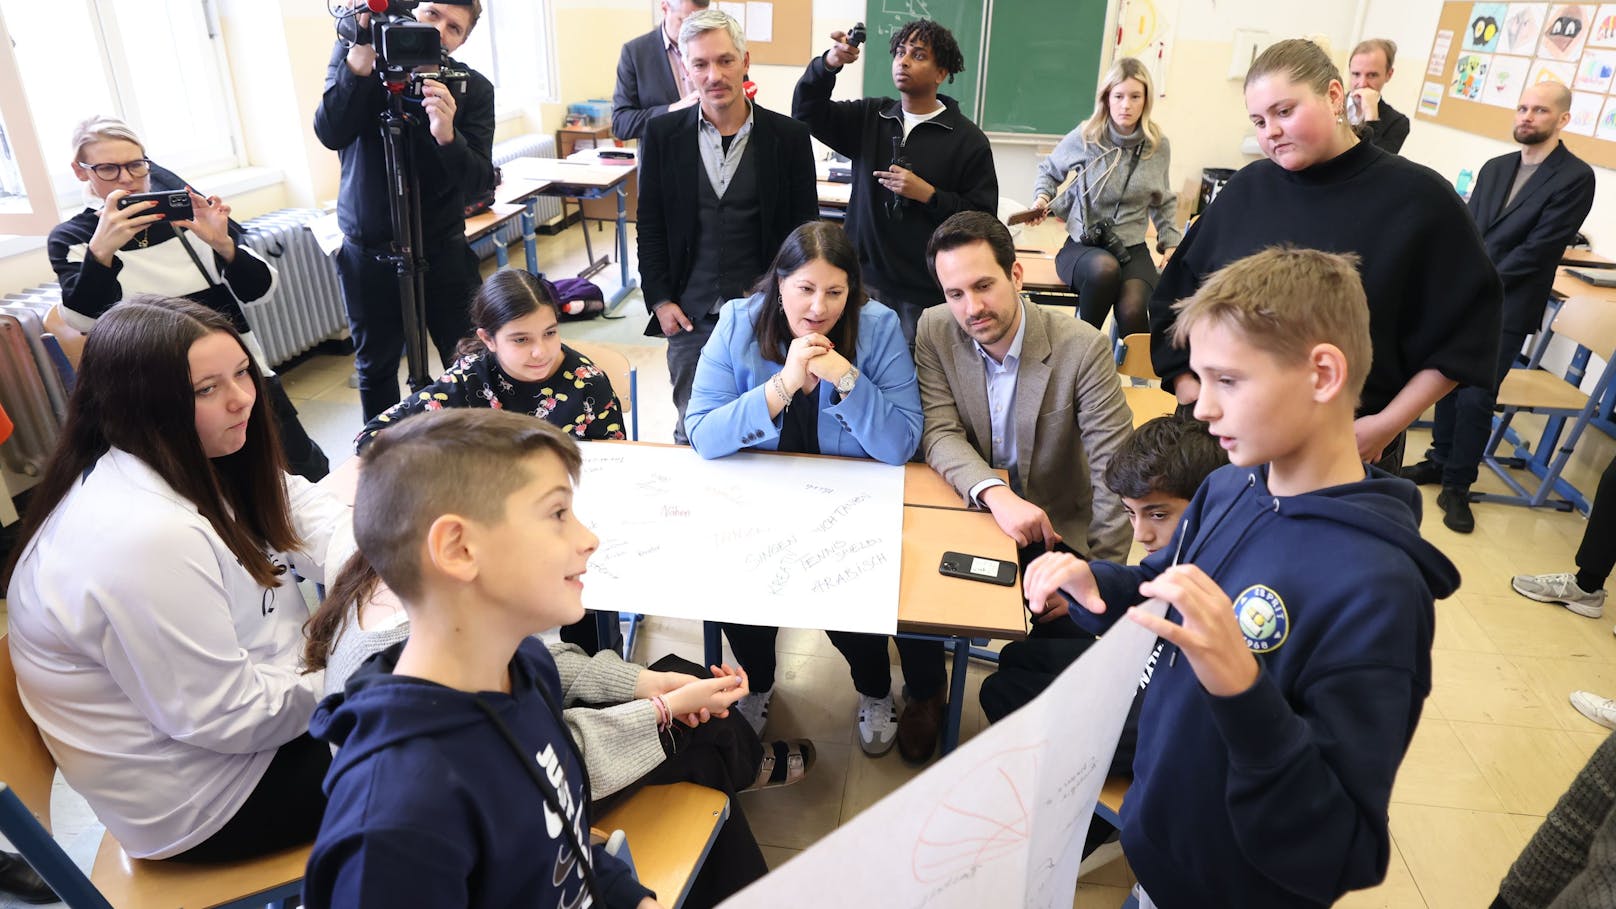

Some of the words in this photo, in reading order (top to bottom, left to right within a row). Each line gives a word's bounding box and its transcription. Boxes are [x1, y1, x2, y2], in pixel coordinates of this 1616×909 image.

[794, 540, 847, 572] TENNIS
[811, 553, 888, 592] ARABISCH
[1253, 587, 1285, 620] ESPRIT
